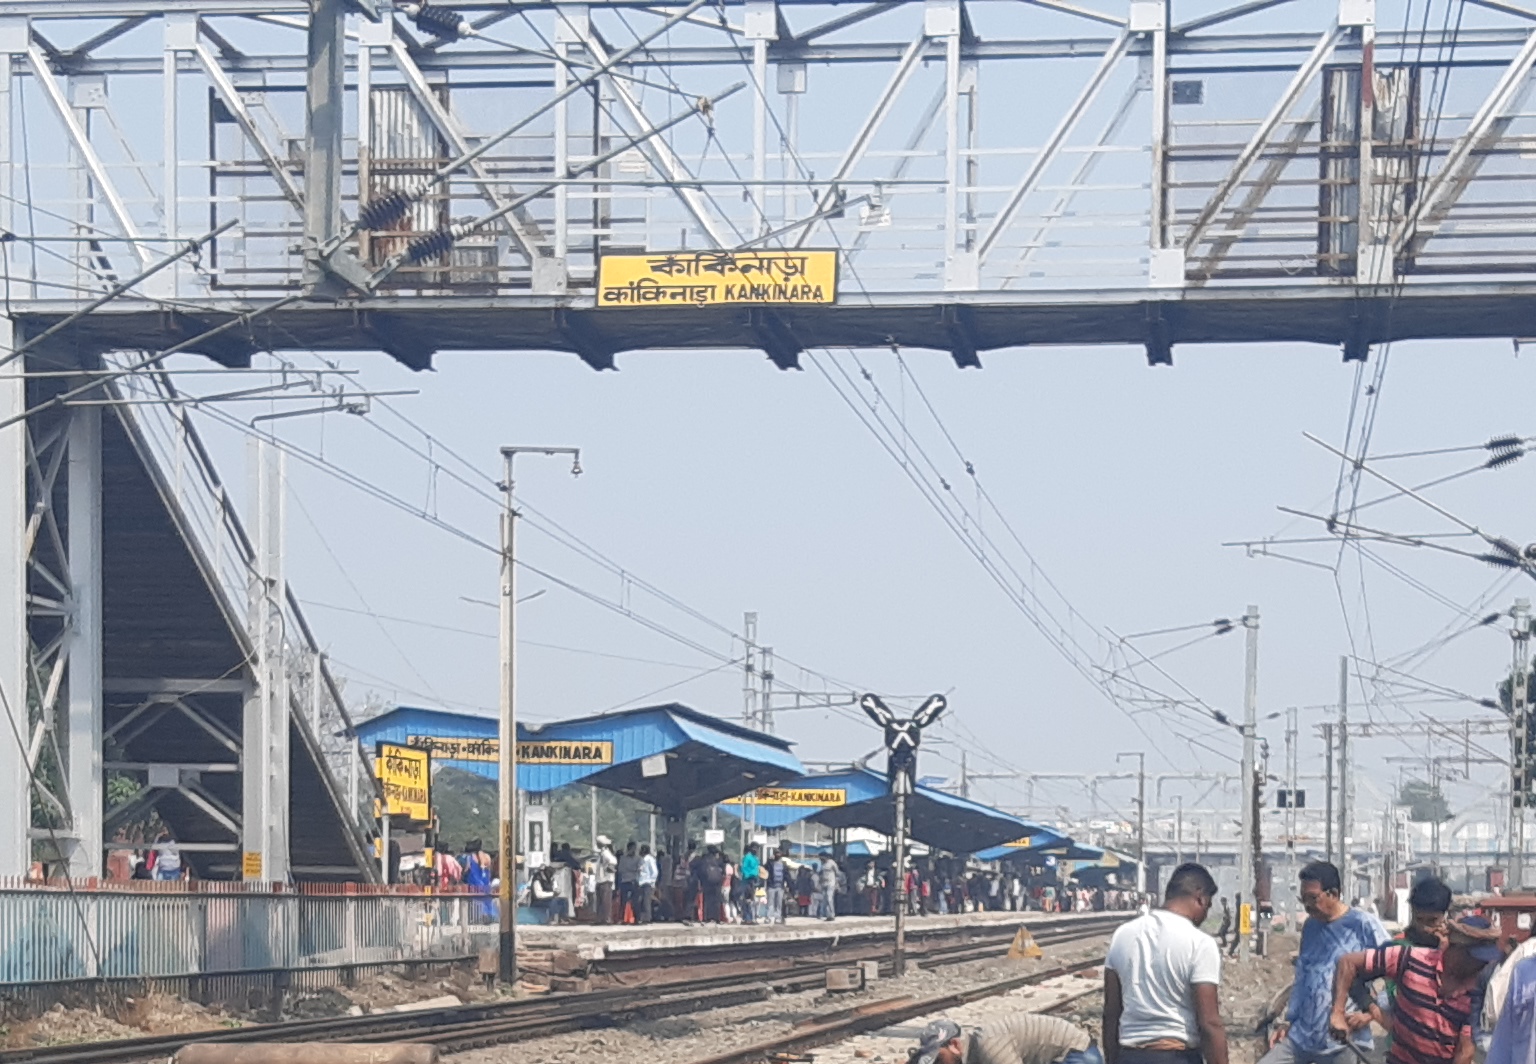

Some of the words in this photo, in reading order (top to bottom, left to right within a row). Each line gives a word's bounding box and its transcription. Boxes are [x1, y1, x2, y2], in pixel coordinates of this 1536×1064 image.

[646, 251, 808, 283] কাঁকিনাড়া
[724, 284, 824, 301] KANKINARA
[522, 746, 602, 760] KANKINARA
